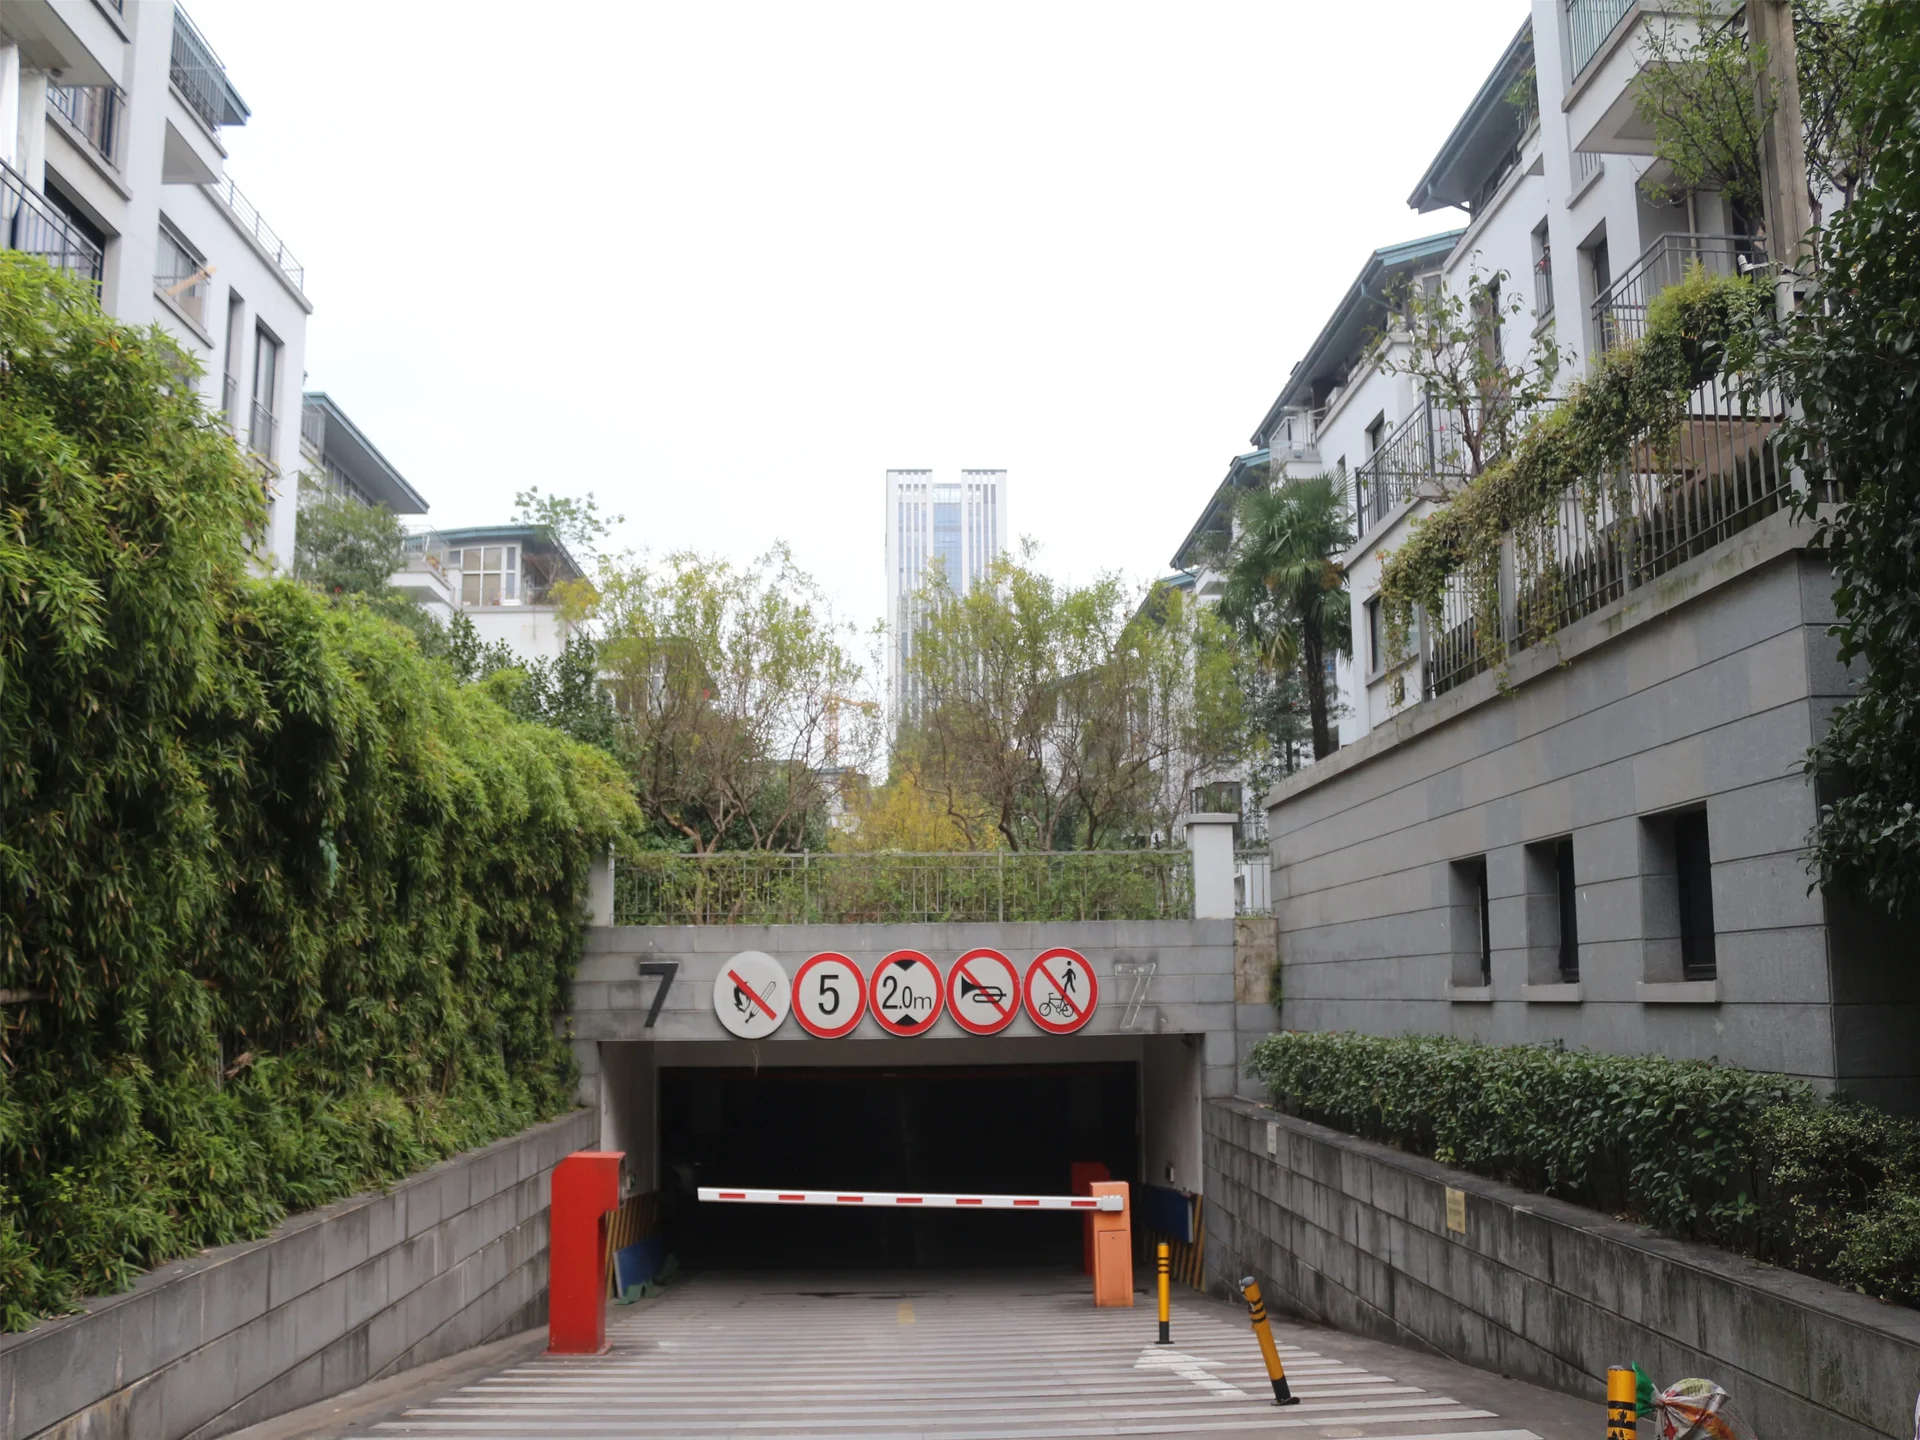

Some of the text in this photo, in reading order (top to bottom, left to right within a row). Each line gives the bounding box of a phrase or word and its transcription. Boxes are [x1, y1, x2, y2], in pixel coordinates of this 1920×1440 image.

[639, 962, 679, 1028] 7
[818, 974, 840, 1016] 5
[882, 975, 932, 1010] 2.0m
